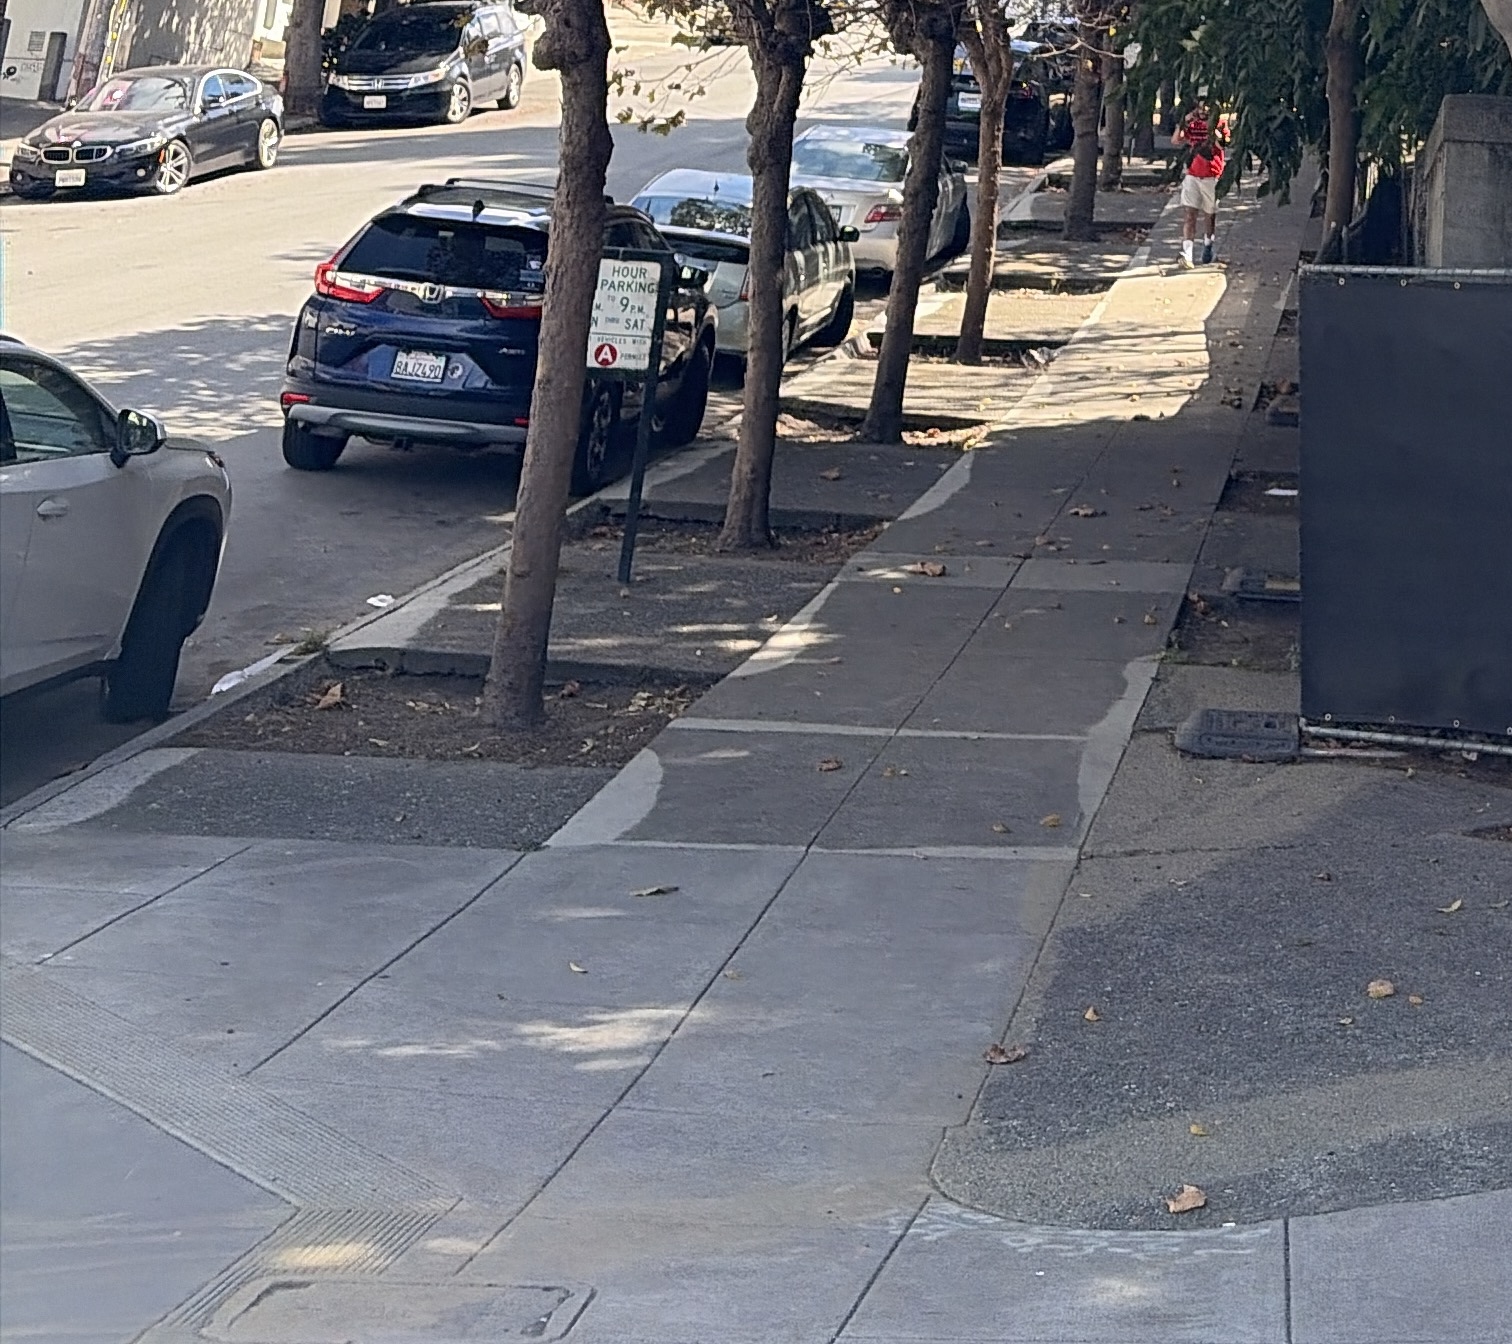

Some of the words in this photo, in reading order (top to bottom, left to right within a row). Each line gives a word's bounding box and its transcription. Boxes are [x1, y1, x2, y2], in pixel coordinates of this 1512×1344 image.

[612, 265, 648, 279] HOUR
[600, 279, 655, 294] PARKING
[620, 296, 630, 313] 9
[625, 318, 646, 331] SAT
[597, 336, 627, 345] VEHICLES
[597, 345, 613, 363] A
